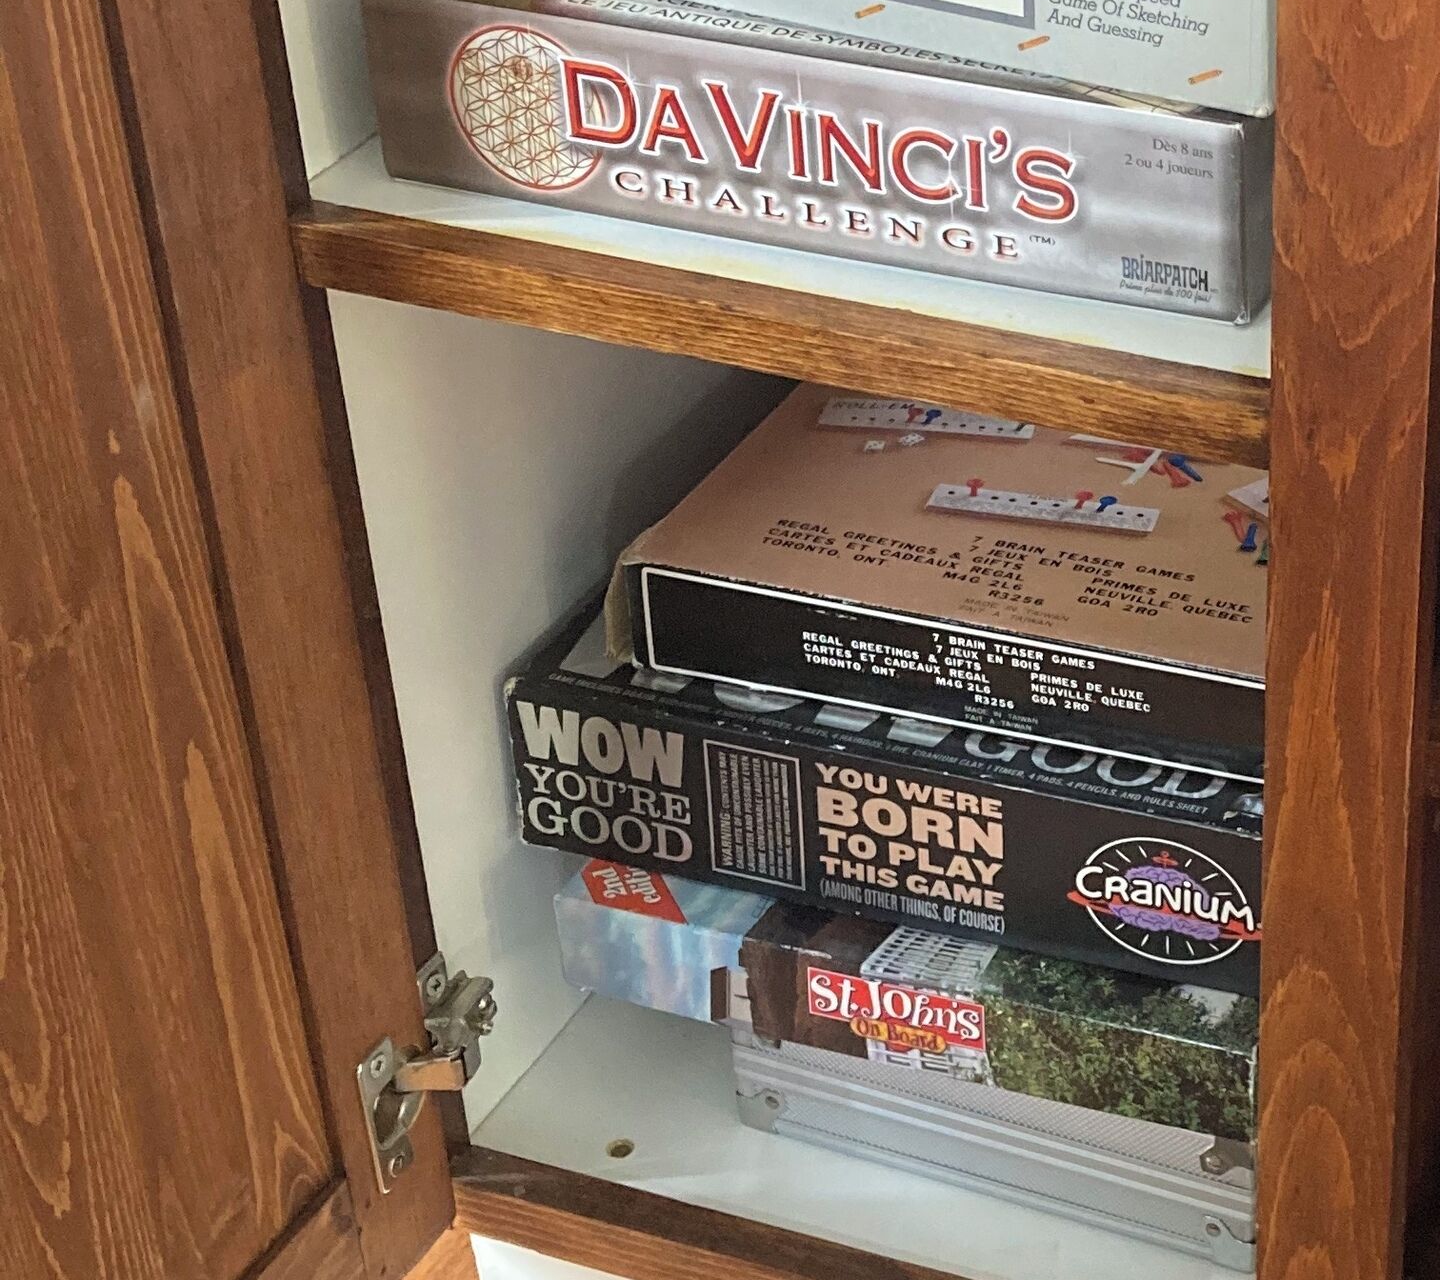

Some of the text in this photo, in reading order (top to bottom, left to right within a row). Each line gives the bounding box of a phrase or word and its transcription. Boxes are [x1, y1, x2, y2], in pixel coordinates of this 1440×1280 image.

[602, 0, 647, 14] JEU
[650, 8, 768, 34] ANTIQUE
[771, 27, 808, 40] DE
[807, 33, 942, 61] SYMBOLES
[1047, 9, 1164, 47] And Guessing
[1126, 3, 1209, 36] Sketching
[1153, 138, 1214, 159] Dès ans
[1136, 158, 1214, 178] ou joueurs
[614, 170, 1020, 258] CHALLENGE
[1121, 253, 1209, 292] BRIARPATCH
[768, 527, 1025, 582] CARTES CADEAUX REGAL
[777, 519, 1025, 571] REGAL GREETINGS GIFTS
[987, 548, 1114, 578] JEUX BOIS
[995, 539, 1197, 583] BRAIN TEASER GAMES
[942, 571, 982, 585] M4G
[1091, 577, 1251, 613] PRIMES DE LUXE
[988, 589, 1046, 606] R3256
[1182, 605, 1254, 624] QUEBEC
[802, 631, 982, 671] REGAL GREETINGS GIFTS
[803, 642, 990, 684] CARTES ET CADEAUX REGAL
[948, 635, 1096, 670] BRAIN TEASER GAMES
[949, 647, 1041, 671] JEUX EN BOIS
[935, 676, 991, 694] M4G 2L6
[974, 694, 1015, 709] R3256
[1030, 672, 1145, 701] PRIMES DE LUXE
[1101, 695, 1151, 713] QUEBEC
[516, 700, 684, 789] WOW
[523, 762, 692, 826] YOU'RE
[815, 762, 1003, 820] YOU WERE
[527, 796, 693, 862] GOOD
[719, 811, 734, 866] WARNING
[816, 785, 1004, 860] BORN
[818, 826, 1003, 887] TO PLAY
[592, 866, 628, 899] 2nd
[819, 855, 1005, 912] THIS GAME
[819, 878, 1006, 936] (AMONG OTHER THINGS, OF COURSE)
[857, 1019, 938, 1051] On Board
